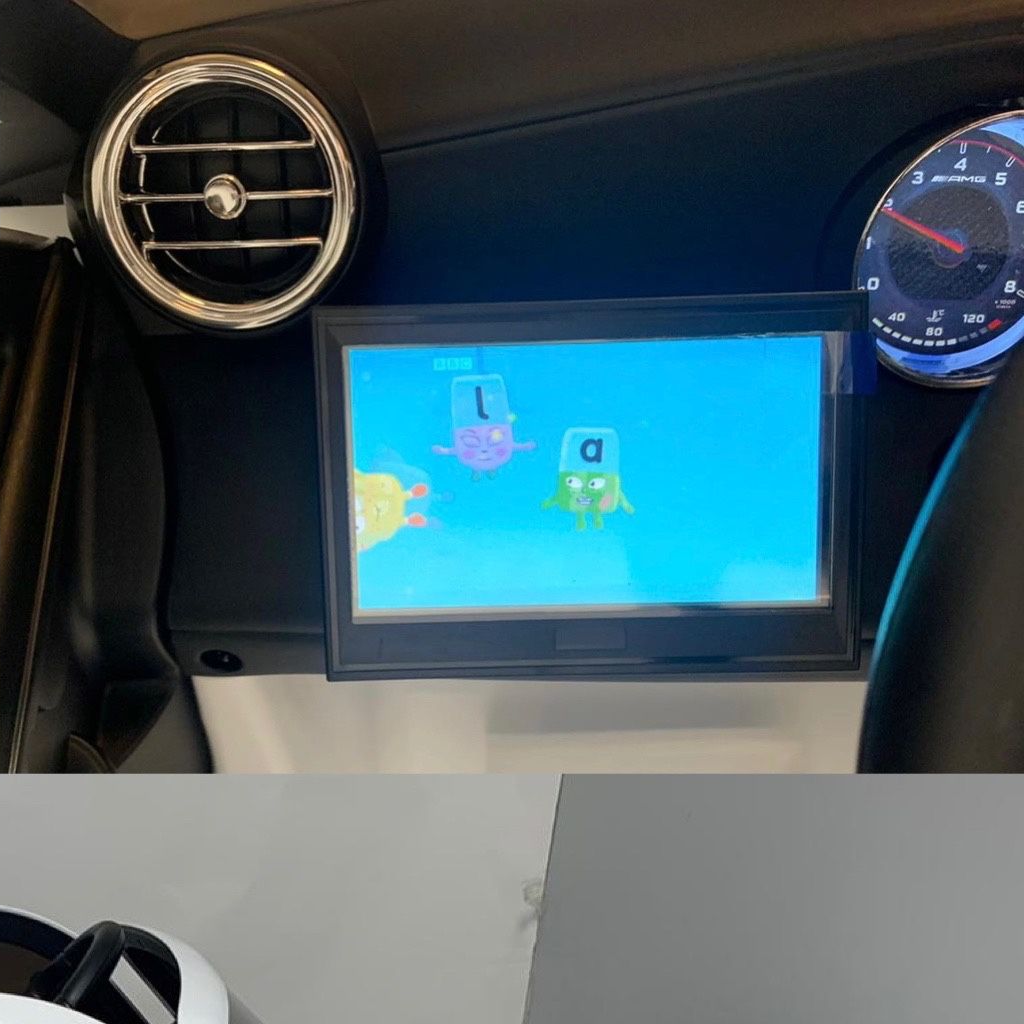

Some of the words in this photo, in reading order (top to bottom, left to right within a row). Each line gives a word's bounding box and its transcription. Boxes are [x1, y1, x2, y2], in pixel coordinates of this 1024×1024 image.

[954, 157, 967, 171] 4
[911, 171, 924, 185] 3
[947, 175, 987, 183] AMG
[994, 172, 1008, 186] 5
[866, 236, 872, 250] 1
[867, 277, 880, 291] 0
[1004, 280, 1017, 293] 8
[888, 312, 906, 322] 40
[962, 314, 985, 324] 120
[925, 327, 943, 336] 80
[579, 438, 603, 464] a
